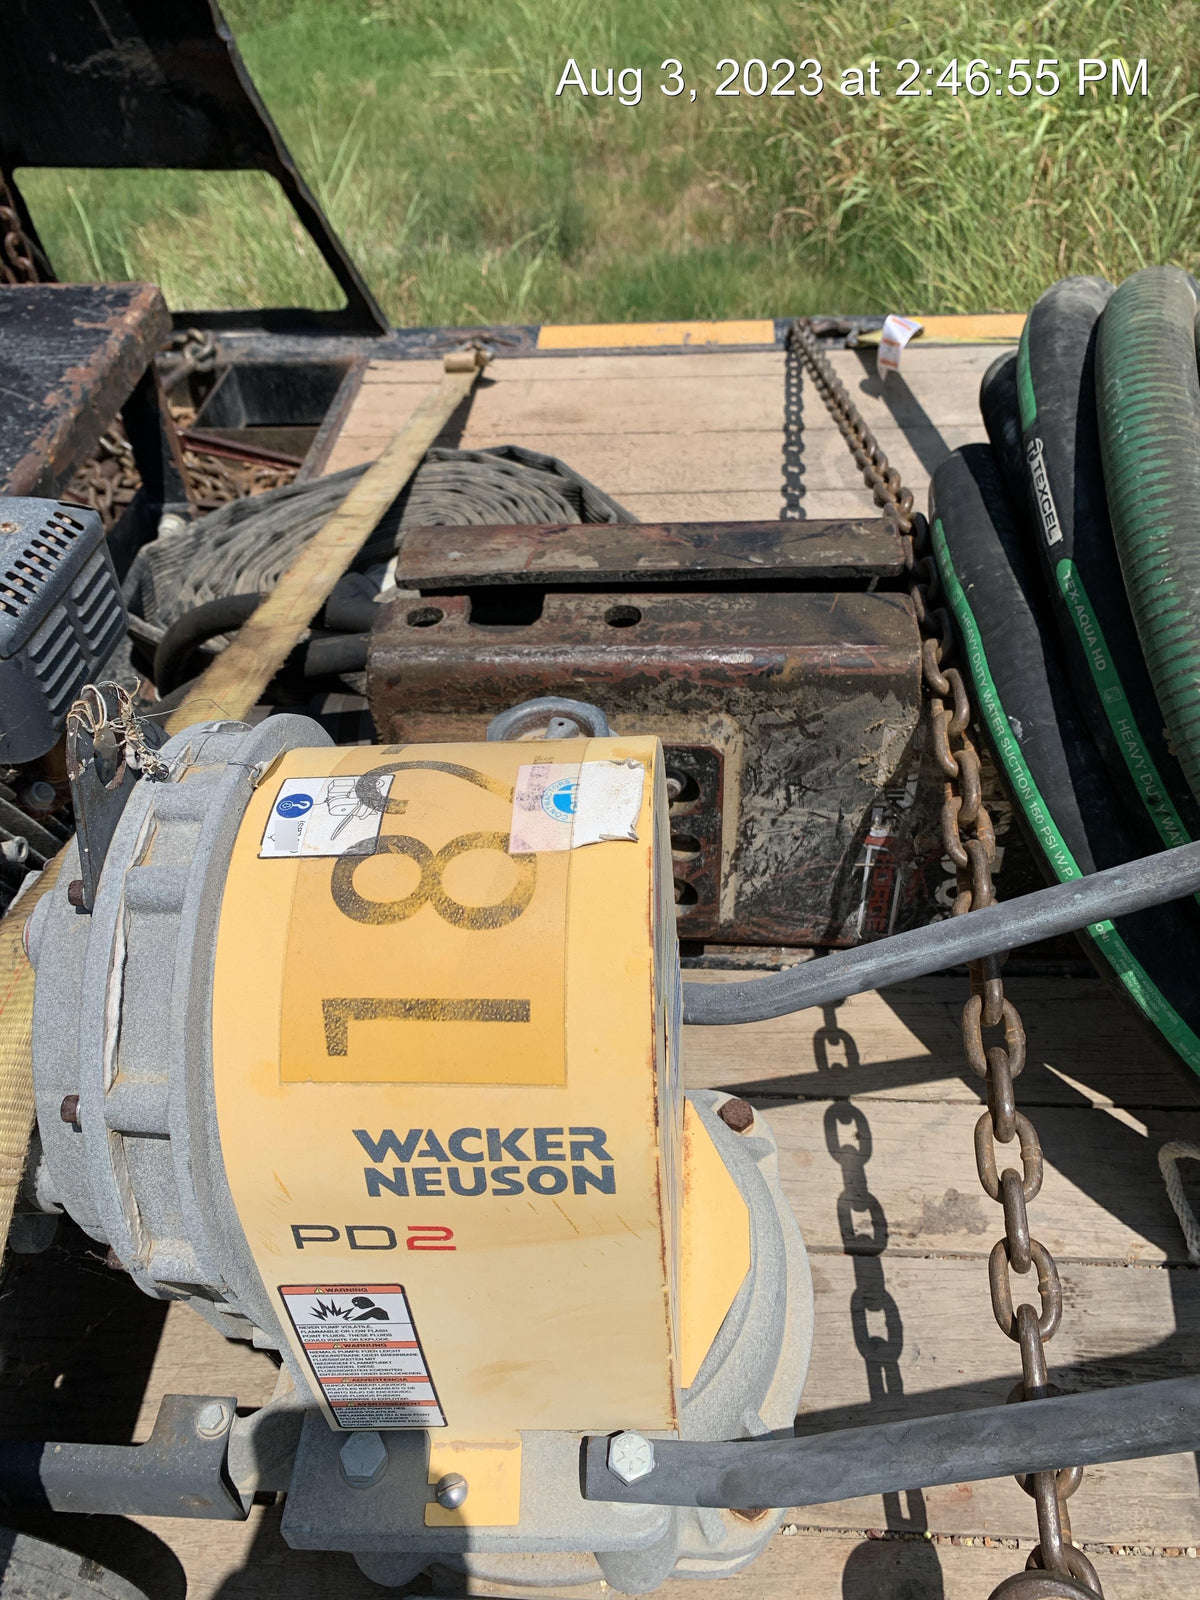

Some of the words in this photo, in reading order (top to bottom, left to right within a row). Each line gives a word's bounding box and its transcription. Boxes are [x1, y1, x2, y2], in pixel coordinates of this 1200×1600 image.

[1033, 462, 1059, 541] TEXCEL
[1063, 569, 1099, 648] TEX-AQUA
[1092, 648, 1107, 671] HD
[961, 611, 979, 651] HEAVY
[972, 652, 989, 688] DUTY
[983, 688, 1006, 738] WATER
[1001, 737, 1034, 801] SUCTION
[1028, 801, 1045, 825] 150
[1040, 826, 1059, 851] PSI
[544, 779, 571, 820] CONTRACTORS
[1117, 718, 1148, 770] HEAVY
[1140, 773, 1168, 815] DUTY
[1160, 815, 1184, 846] WAT
[352, 1126, 614, 1163] WACKER
[363, 1164, 617, 1197] NEUSON
[290, 1224, 457, 1250] PD2
